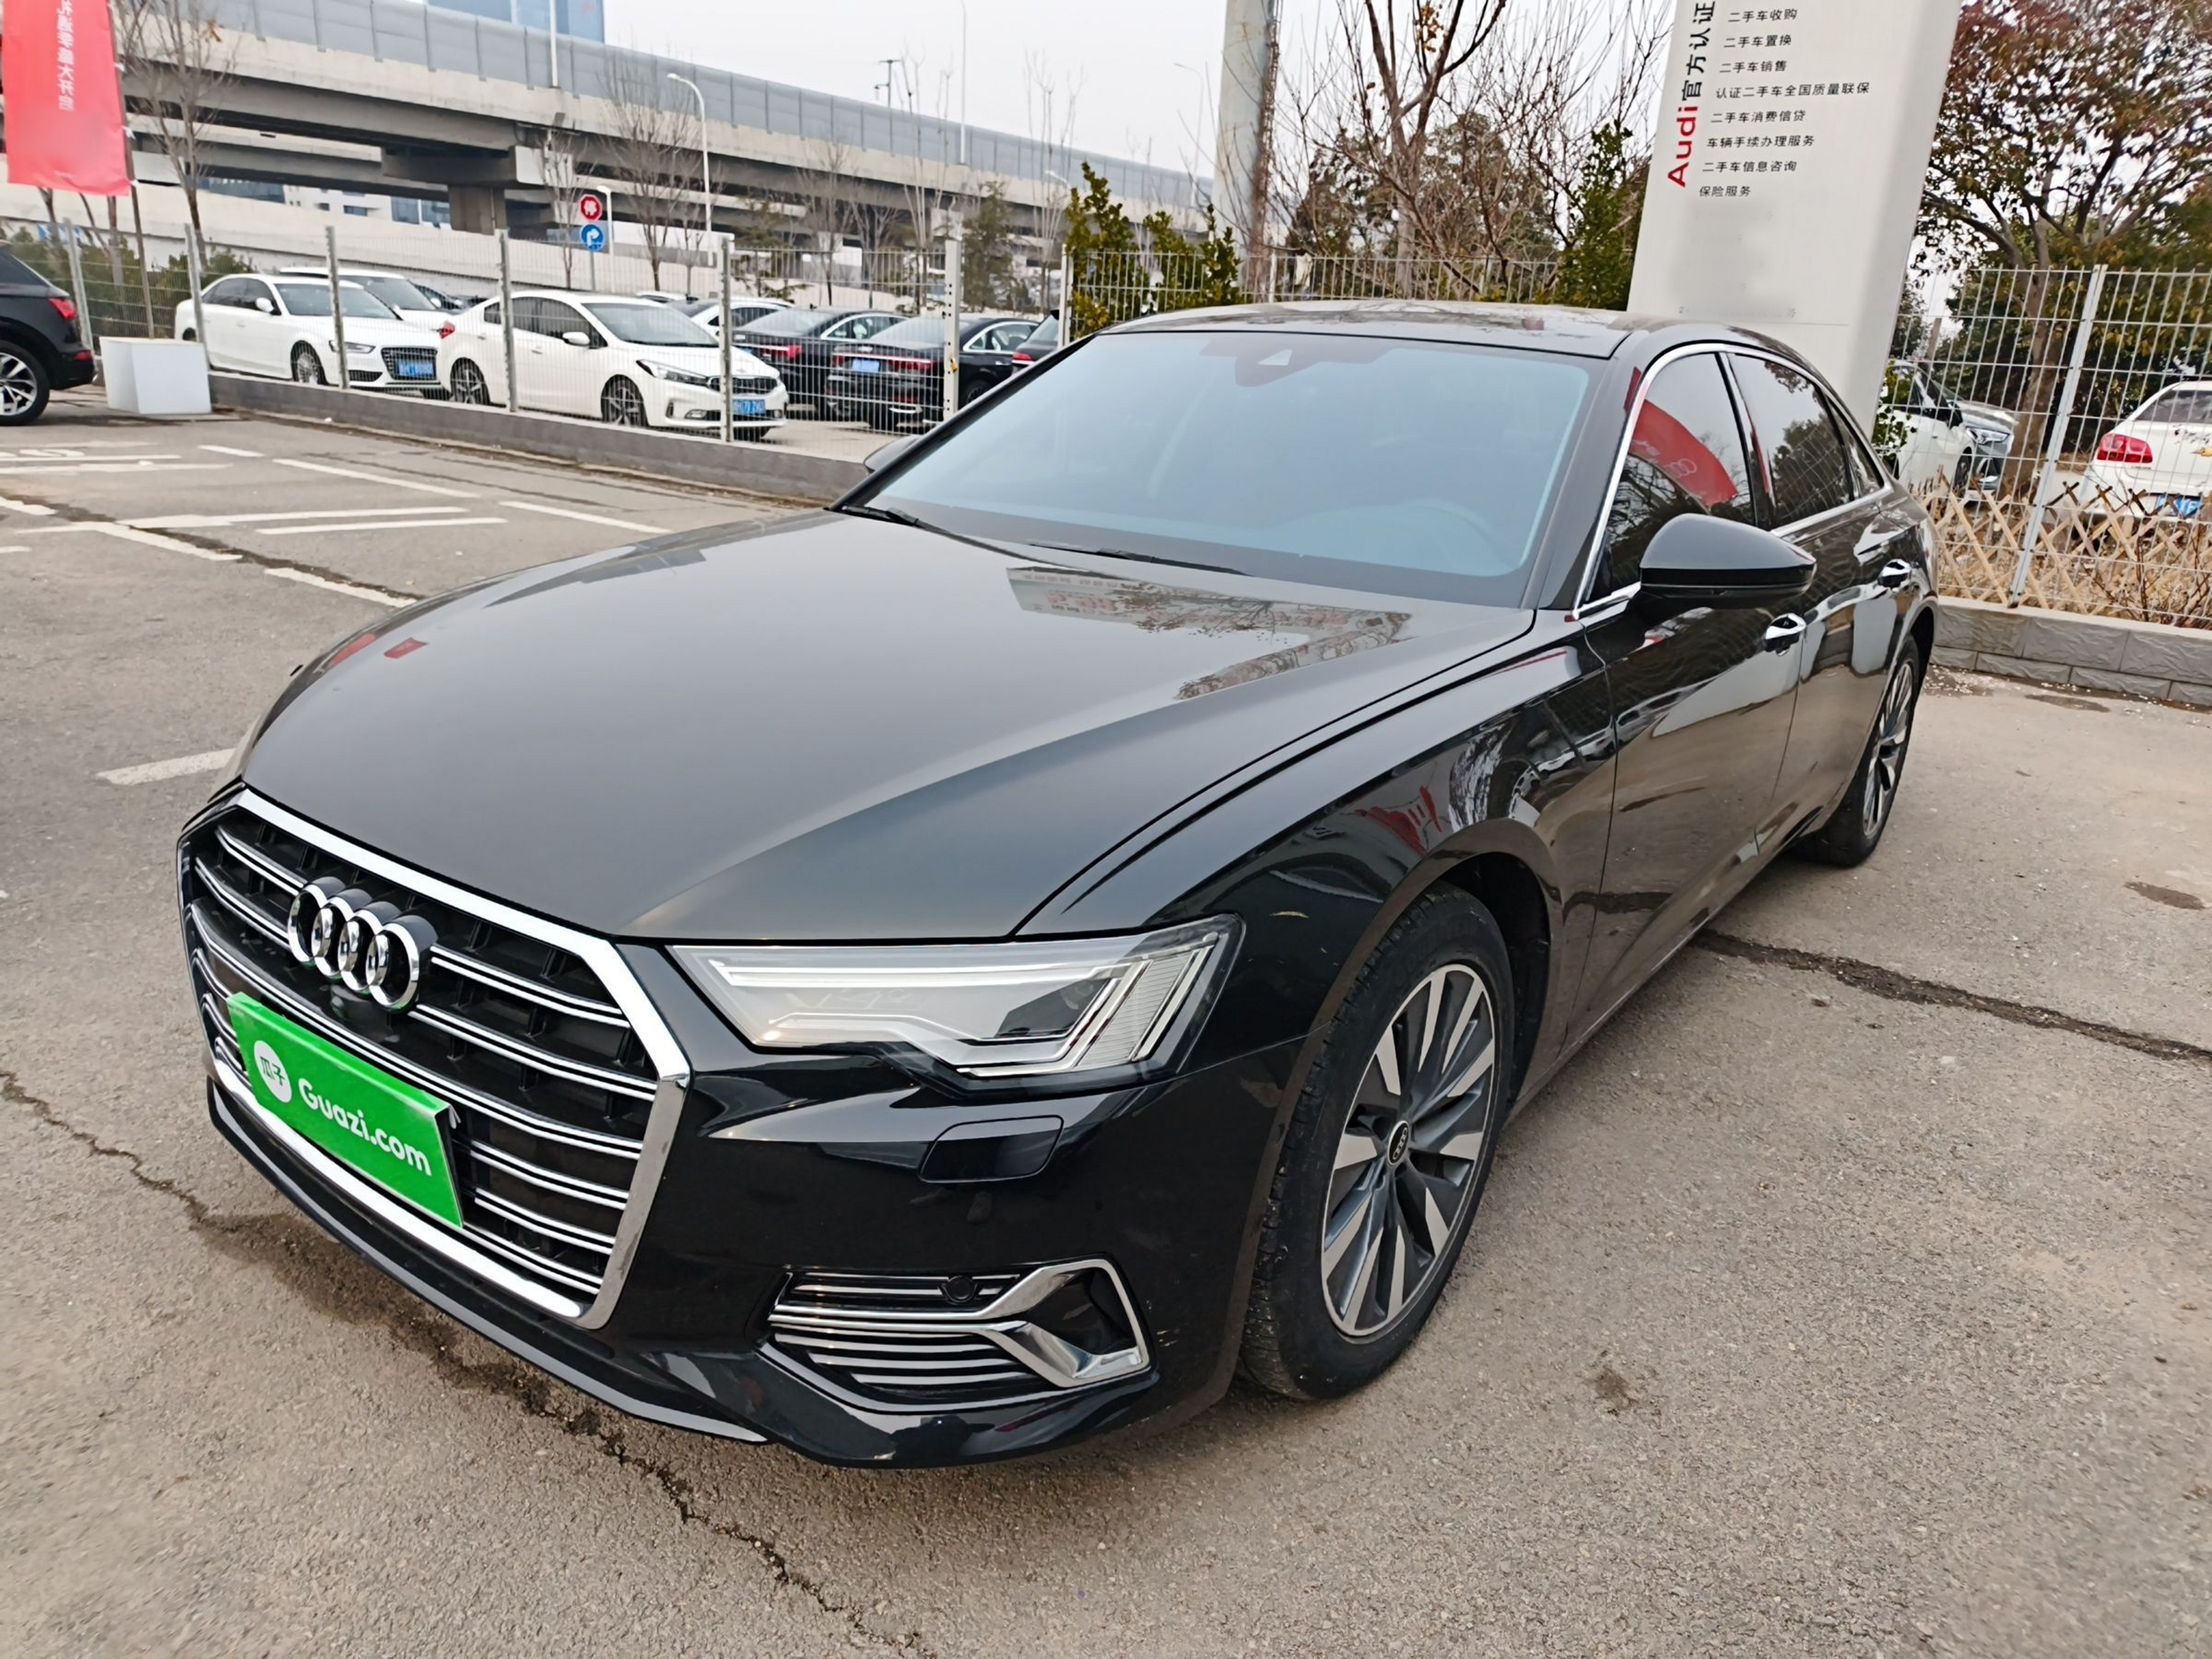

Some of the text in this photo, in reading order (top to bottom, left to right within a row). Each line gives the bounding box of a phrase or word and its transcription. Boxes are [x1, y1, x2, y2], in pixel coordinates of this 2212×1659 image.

[1728, 8, 1798, 22] 二手车收购
[1724, 34, 1792, 48] 二手车置换
[1719, 60, 1787, 73] 二手车销售
[1715, 82, 1870, 99] 认证二手车全国质量联保
[1711, 109, 1806, 124] 二手车消费信贷
[1706, 135, 1815, 148] 车辆手续办理服务
[1702, 161, 1797, 173] 二手车信息咨询
[1699, 185, 1751, 198] 保险服务
[260, 1056, 431, 1176] 瓜子 Guazi.com
